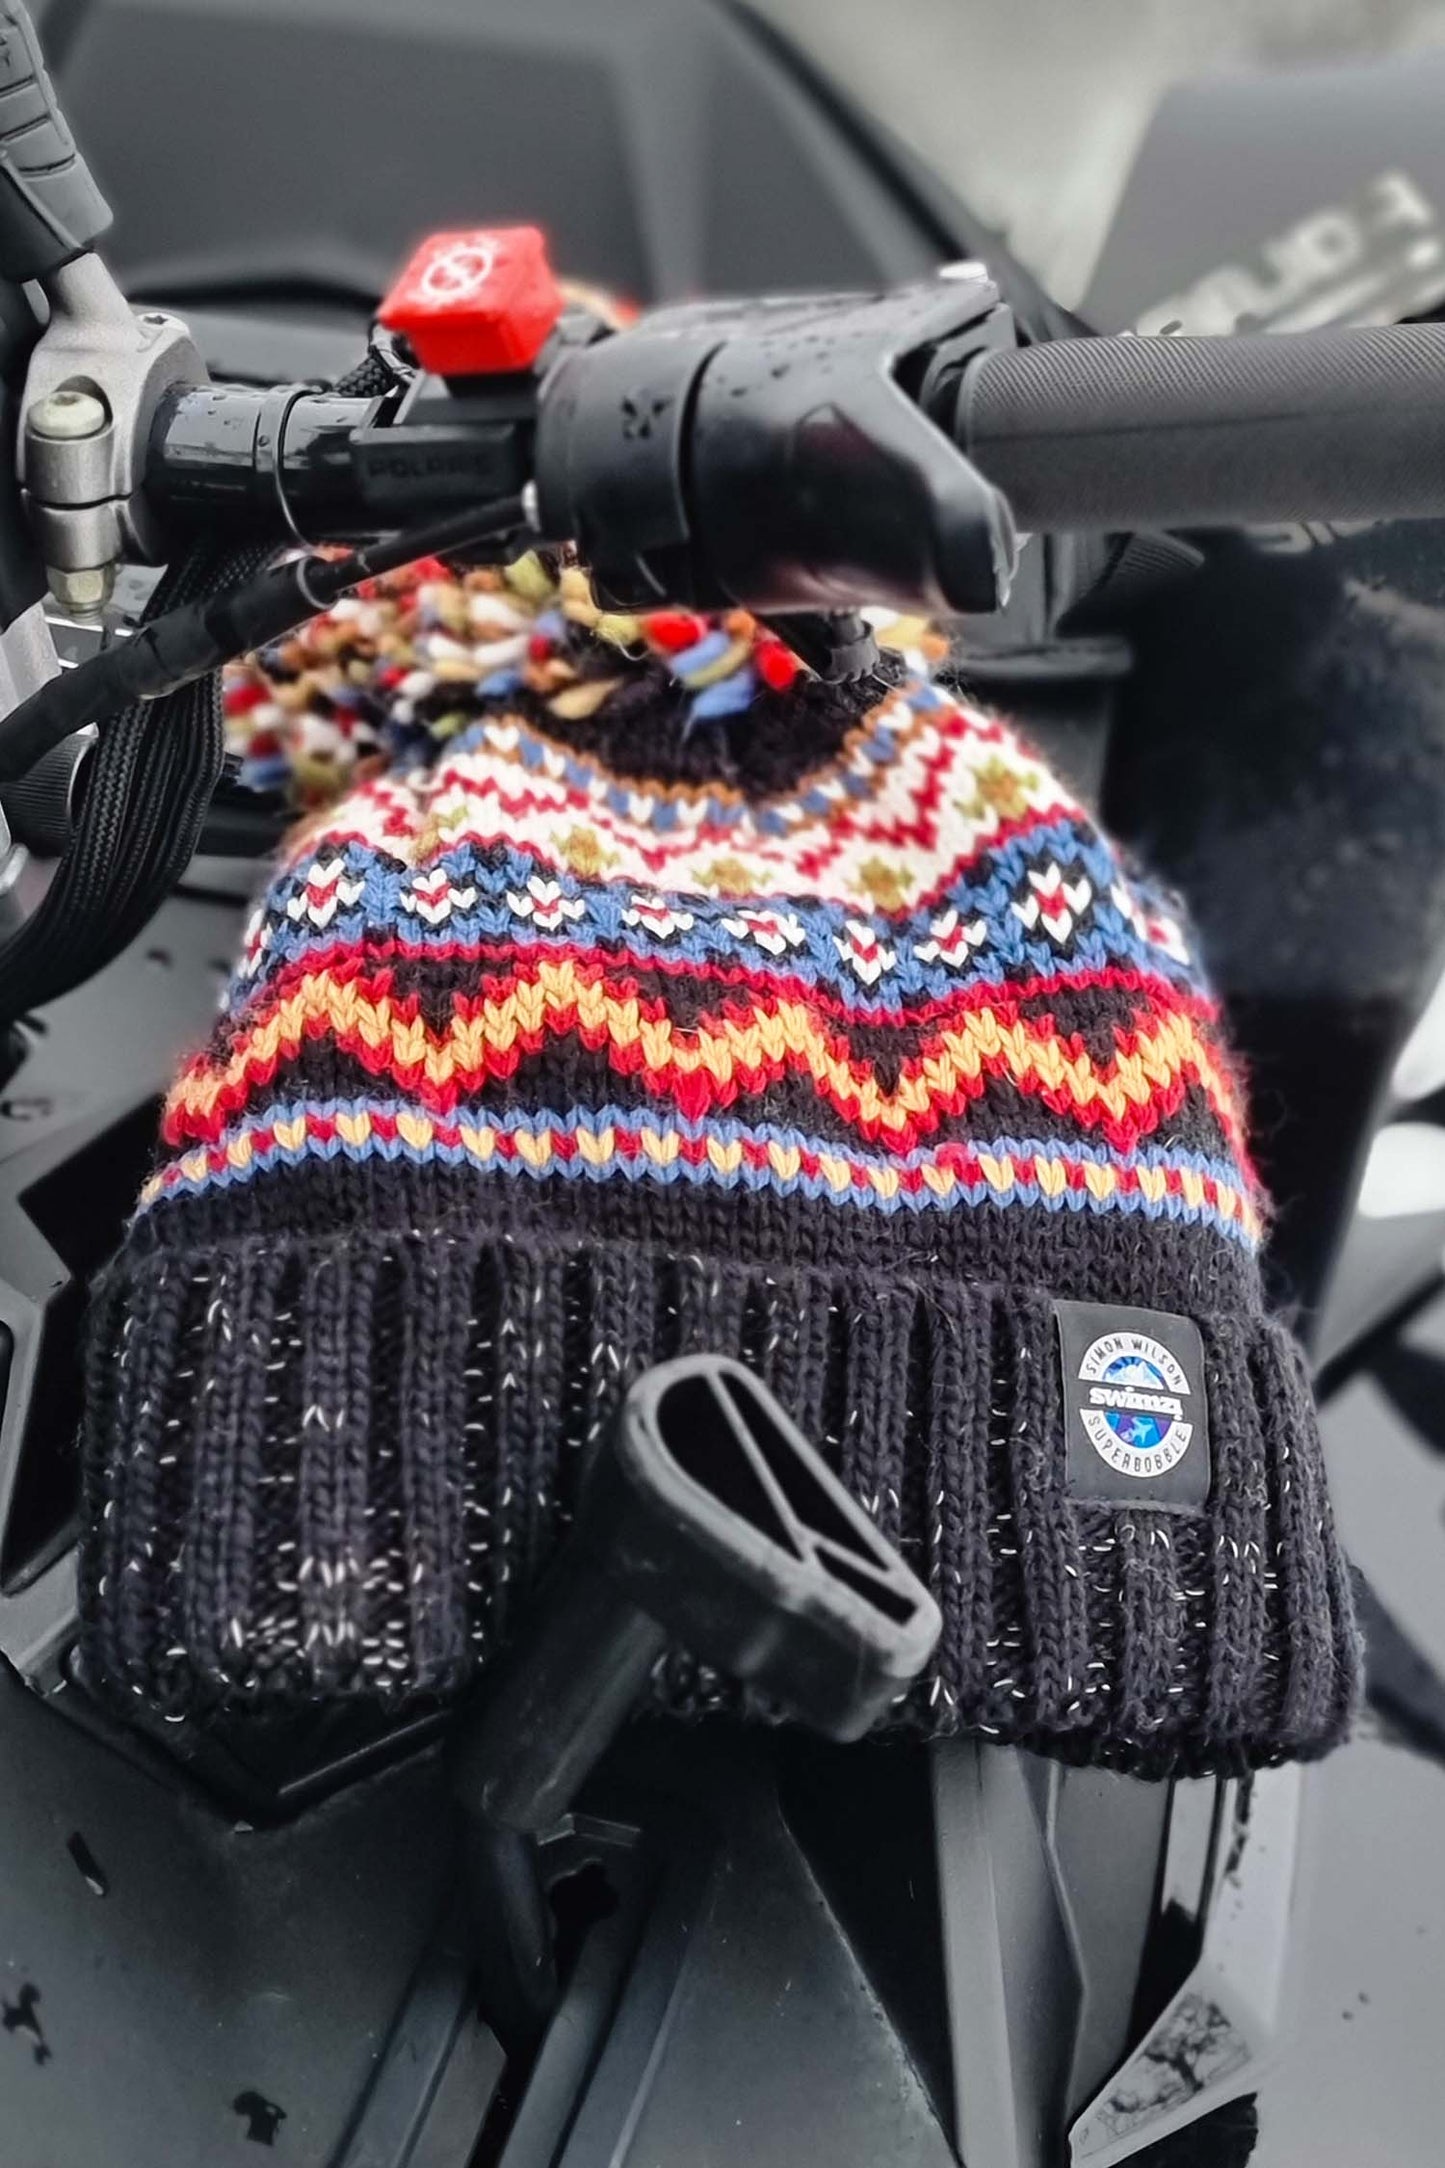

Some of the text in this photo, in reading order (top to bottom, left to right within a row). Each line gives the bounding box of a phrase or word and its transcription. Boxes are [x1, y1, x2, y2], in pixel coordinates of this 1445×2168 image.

[1086, 1338, 1182, 1385] SIMON WILSON
[1088, 1415, 1187, 1472] SUPERBOBBLE
